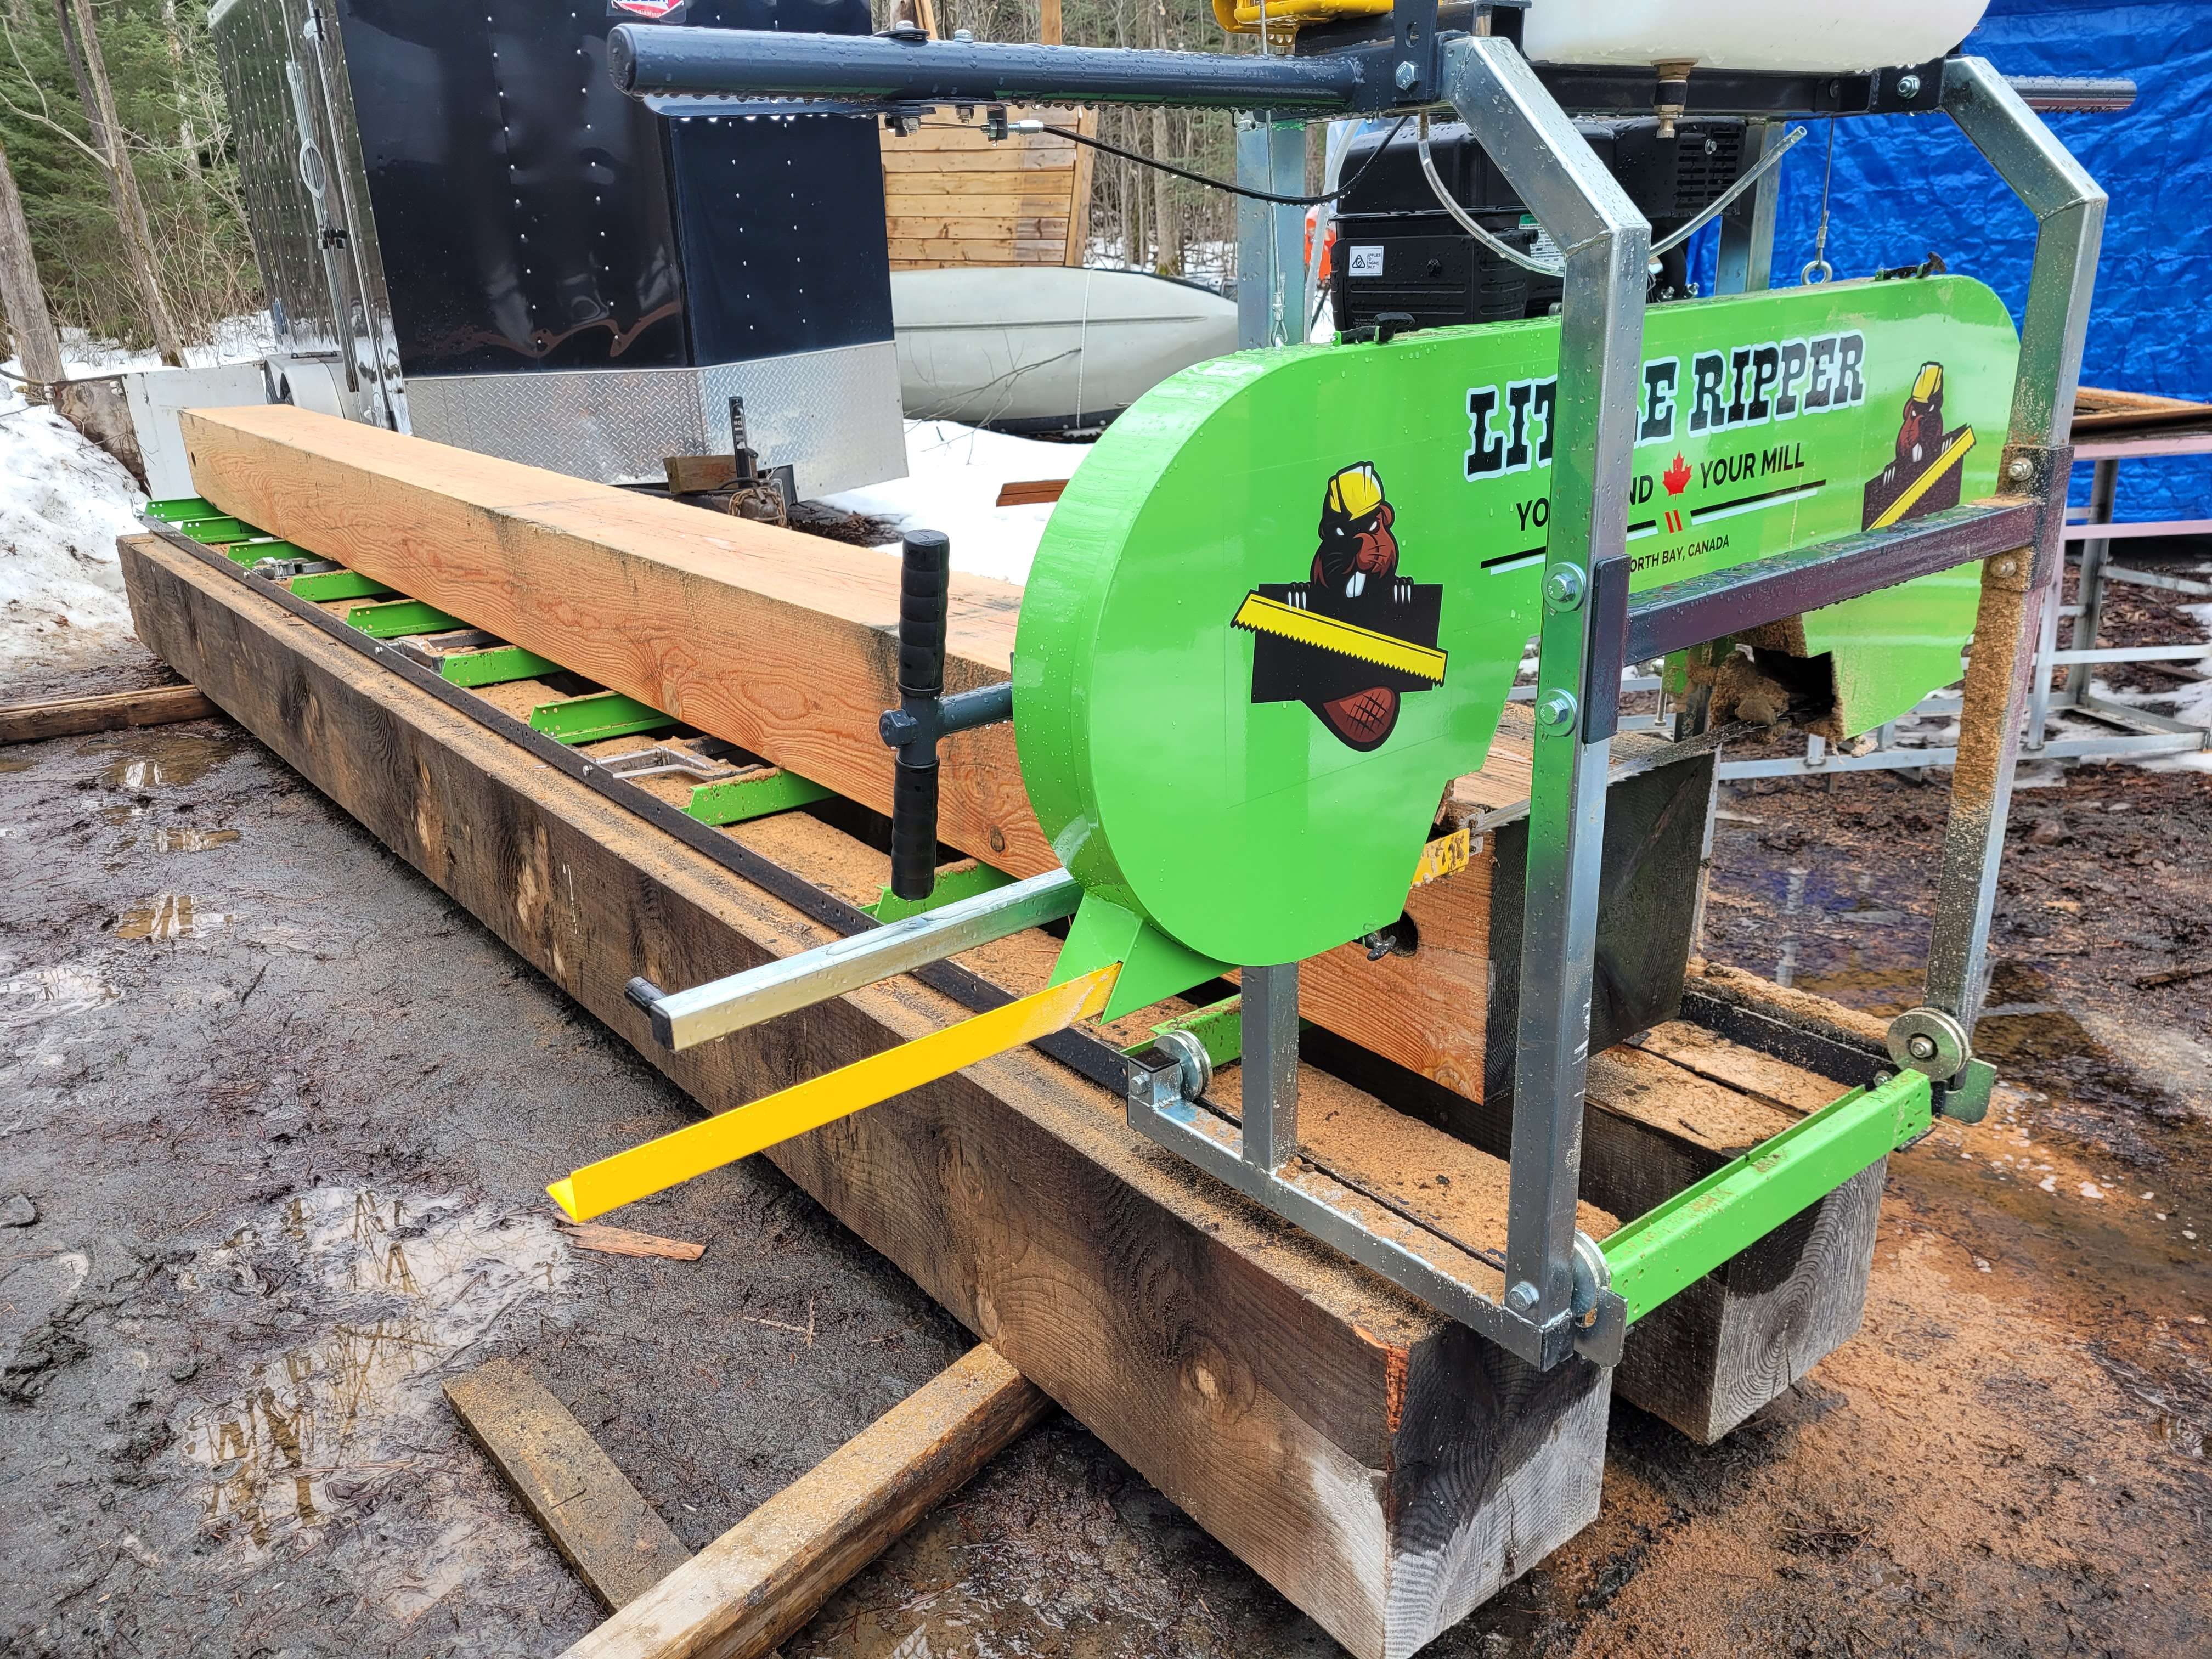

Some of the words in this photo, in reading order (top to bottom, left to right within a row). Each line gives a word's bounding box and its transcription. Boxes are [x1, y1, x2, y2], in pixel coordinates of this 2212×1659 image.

[1465, 357, 1680, 481] LITE
[1687, 330, 1866, 437] RIPPER
[1516, 497, 1549, 531] YO
[1700, 452, 1755, 489] YOUR
[1760, 442, 1804, 476] MILL
[1630, 552, 1660, 573] ORTH
[1662, 546, 1685, 565] BAY,
[1688, 534, 1730, 557] CANADA
